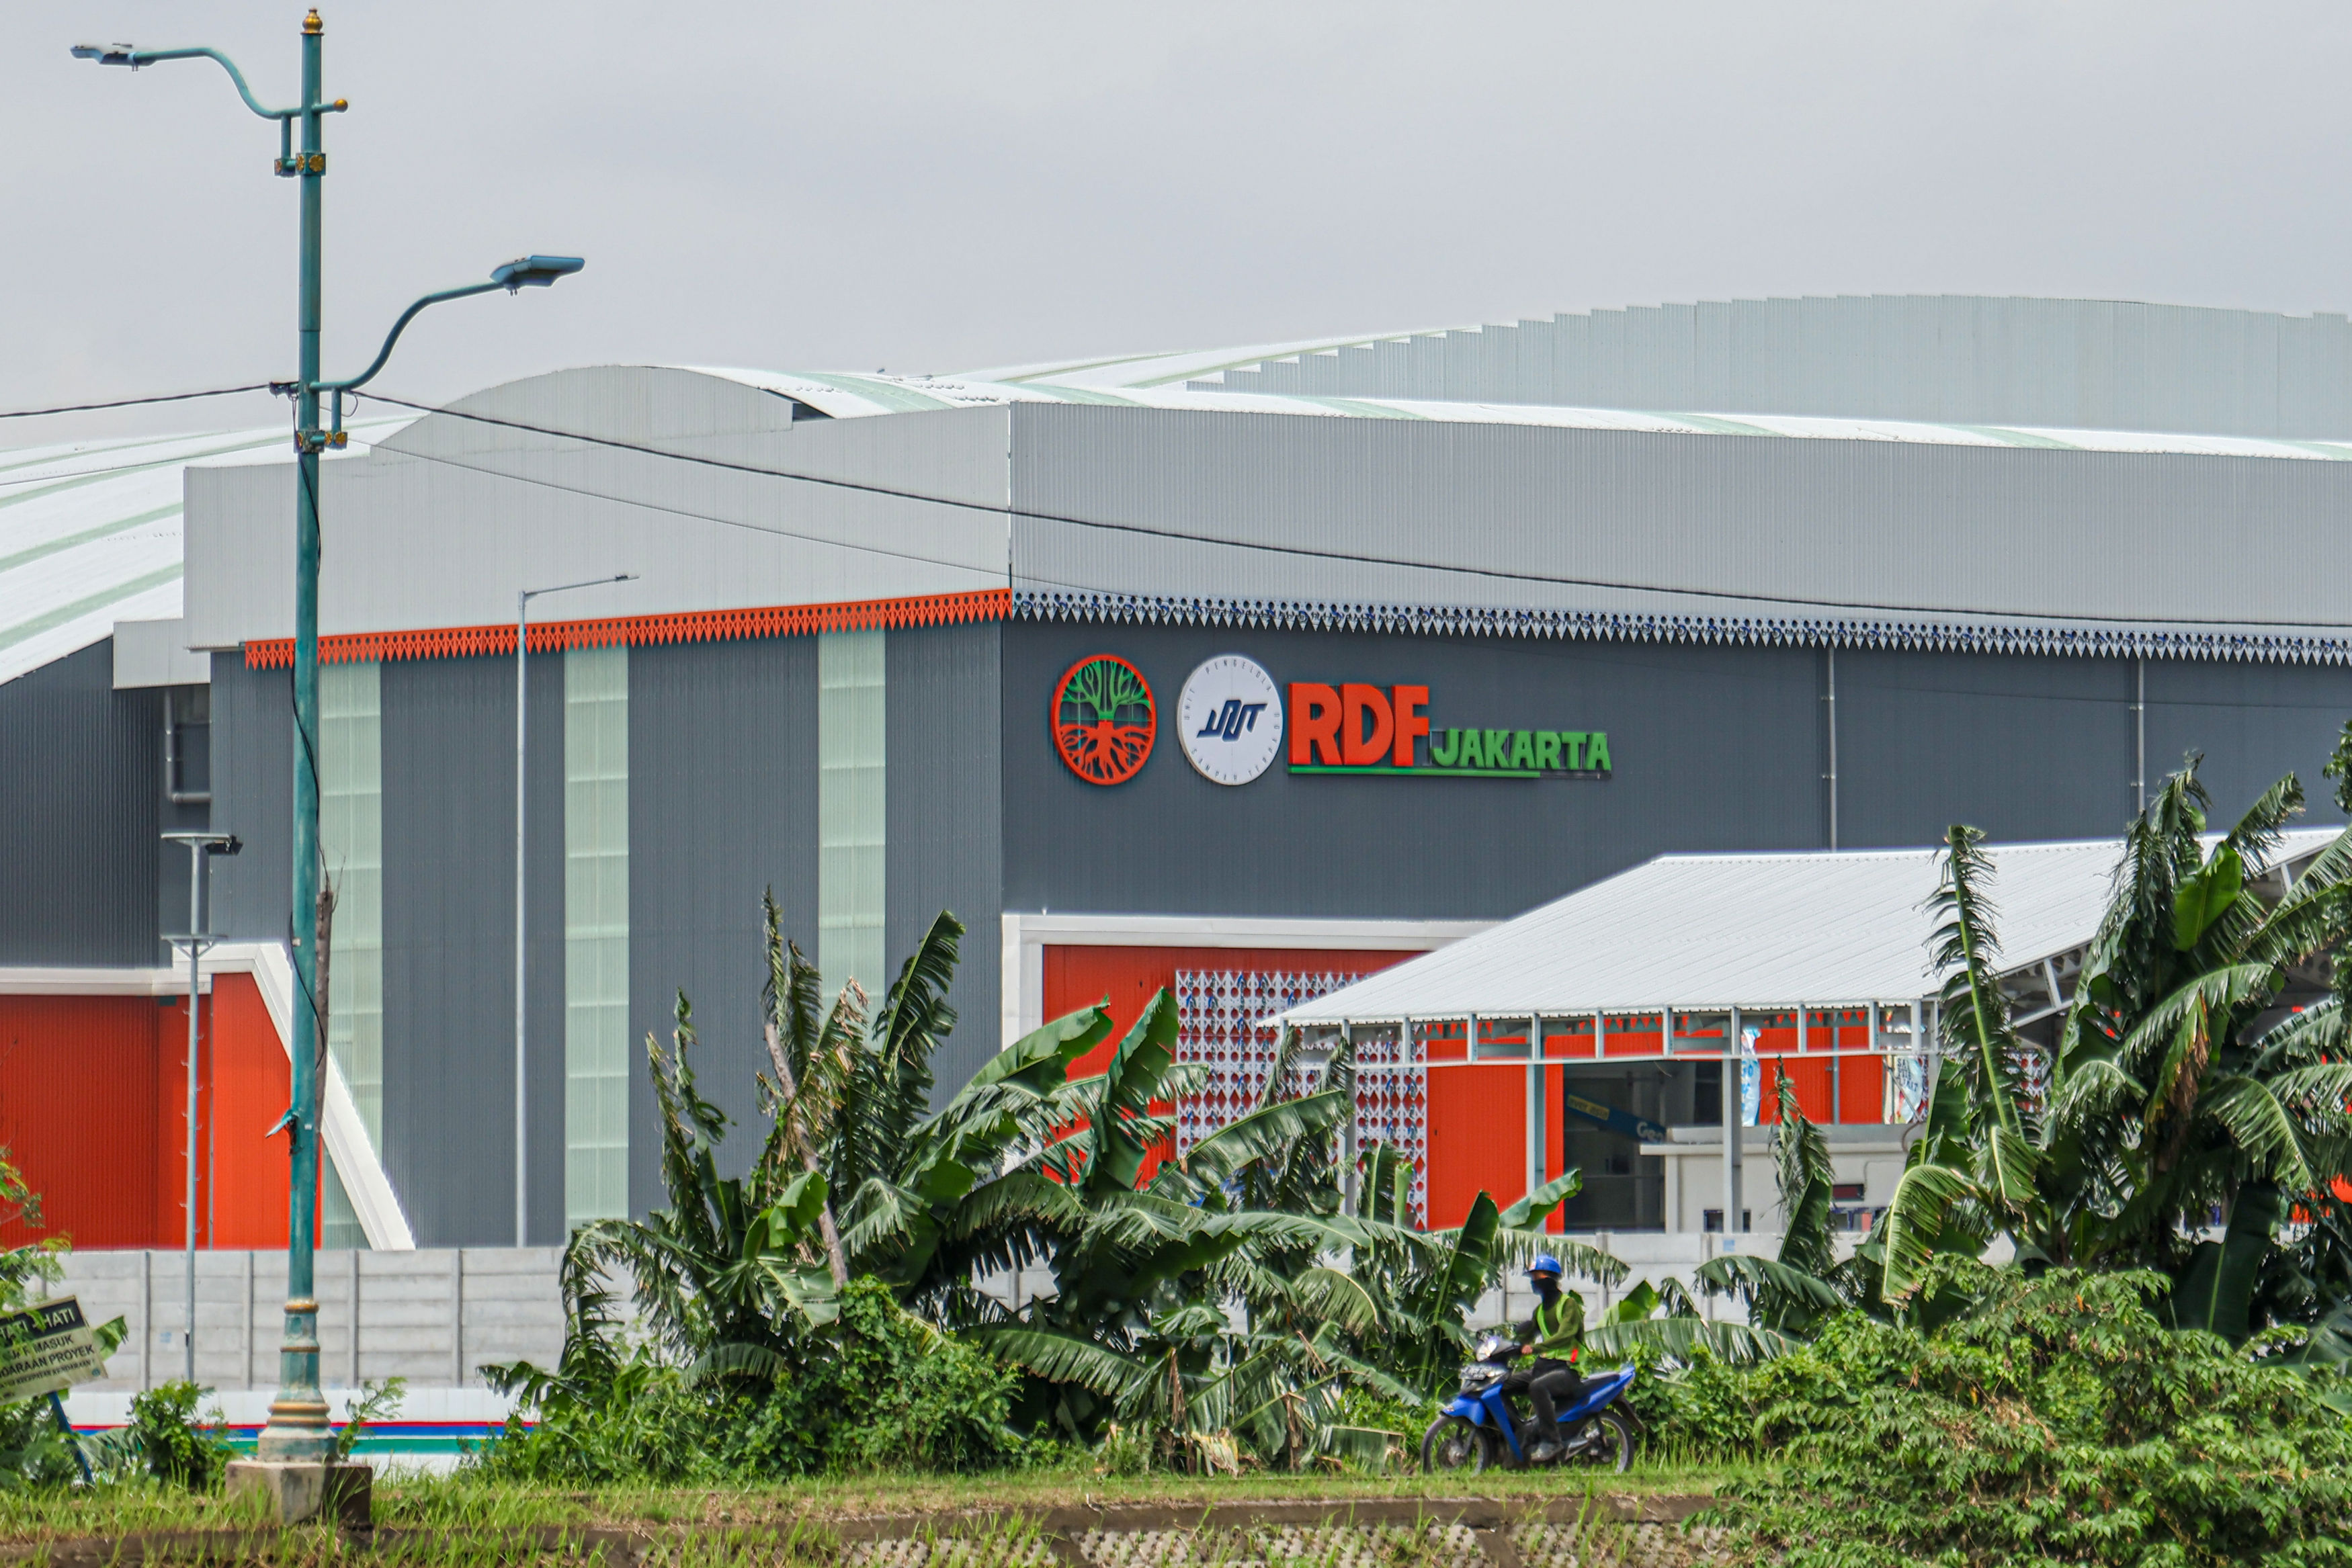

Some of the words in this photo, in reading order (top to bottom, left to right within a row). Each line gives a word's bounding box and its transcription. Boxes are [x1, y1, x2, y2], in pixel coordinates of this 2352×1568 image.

[1288, 682, 1429, 767] RDF
[1430, 728, 1611, 771] JAKARTA
[34, 1334, 74, 1354] MASUK
[48, 1344, 95, 1365] PROYEK
